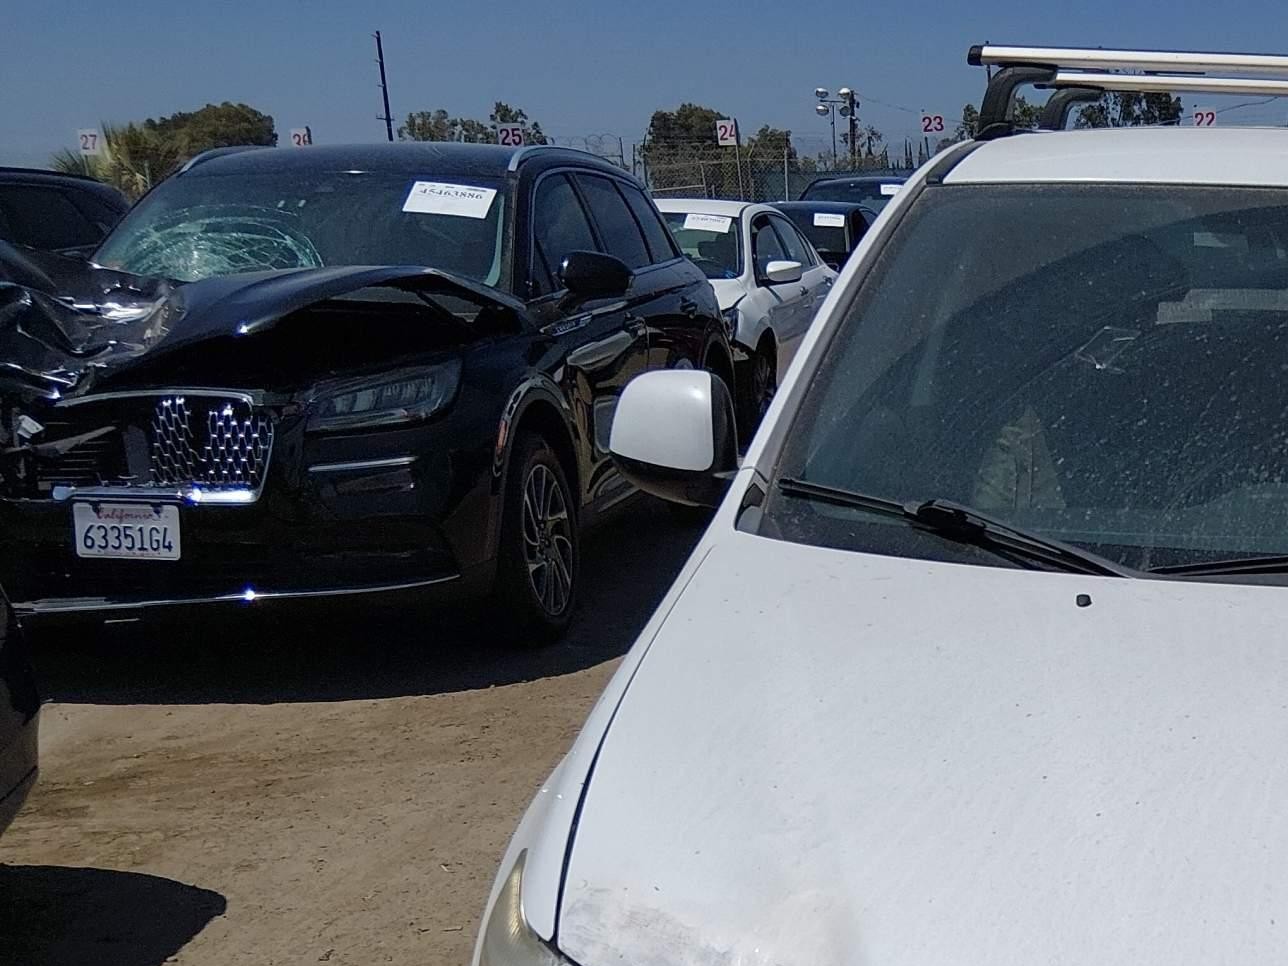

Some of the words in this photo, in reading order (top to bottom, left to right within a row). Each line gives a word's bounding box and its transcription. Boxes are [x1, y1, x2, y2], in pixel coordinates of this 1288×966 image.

[922, 116, 944, 132] 23
[80, 134, 97, 150] 27
[500, 128, 522, 146] 25
[83, 524, 173, 552] 63351G4
